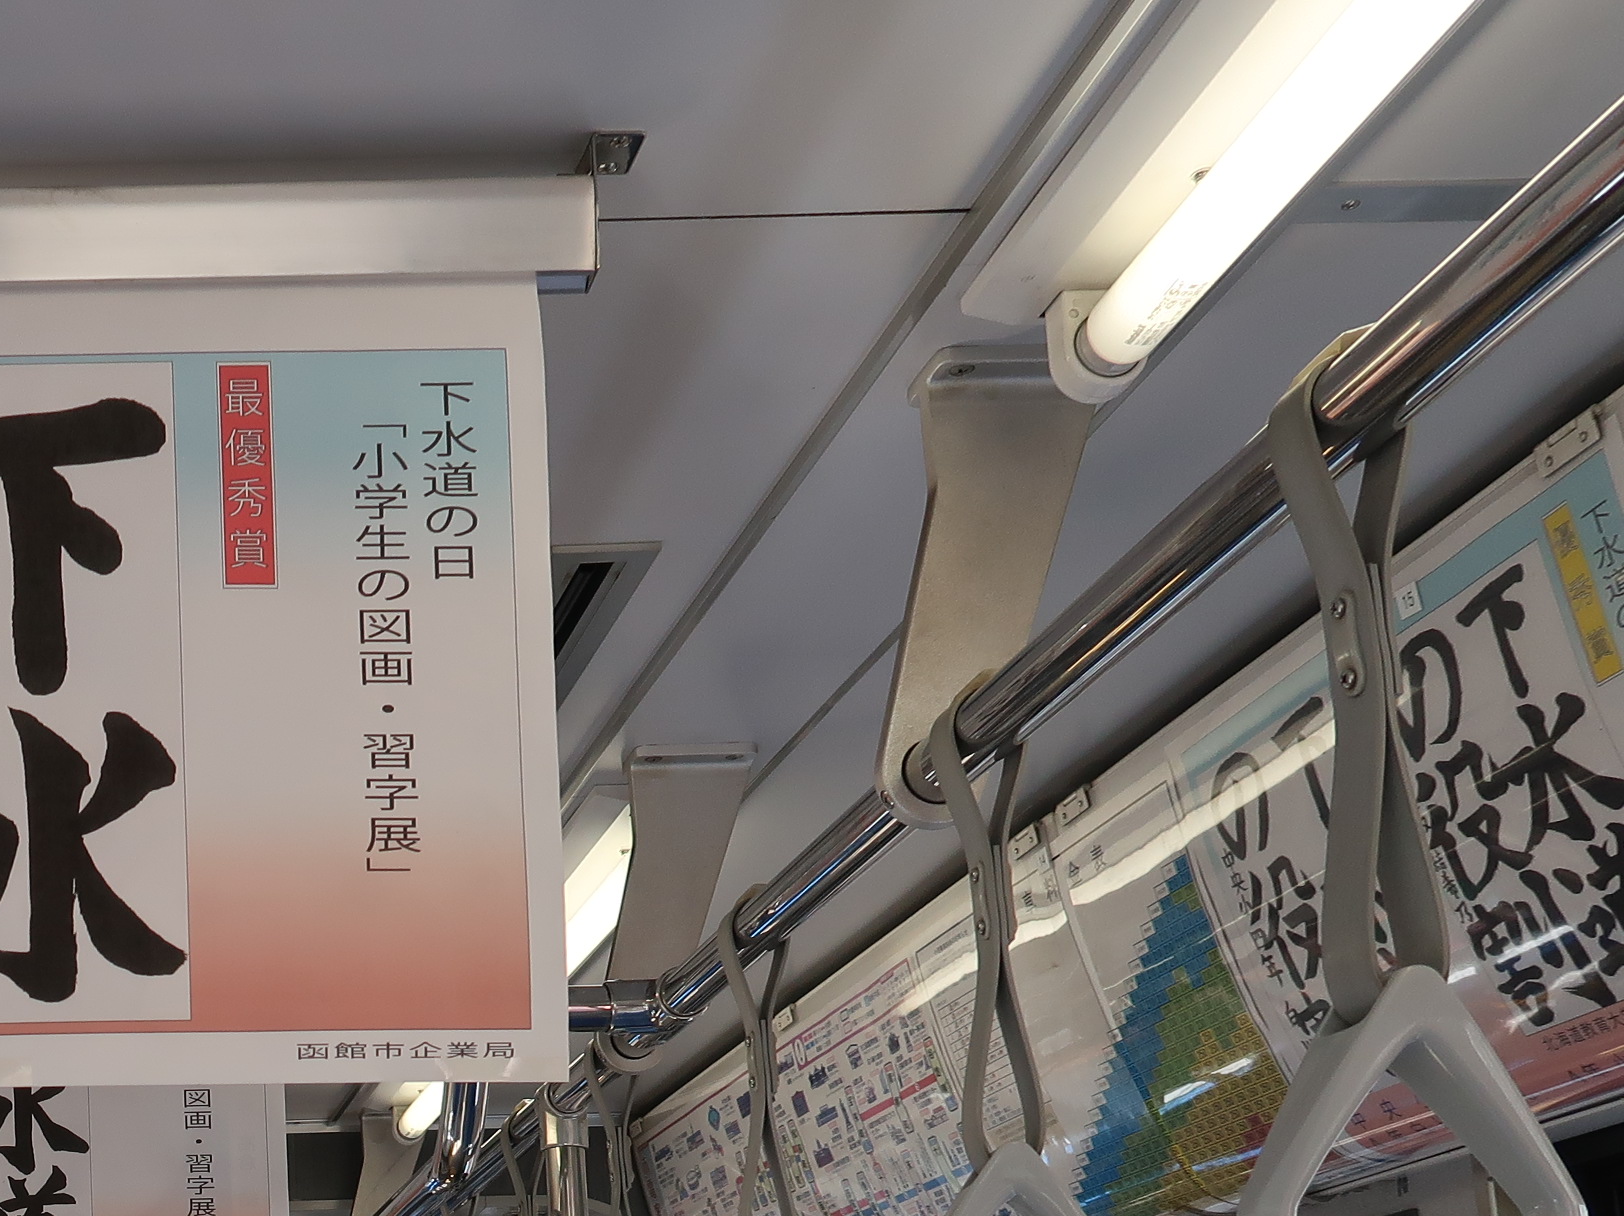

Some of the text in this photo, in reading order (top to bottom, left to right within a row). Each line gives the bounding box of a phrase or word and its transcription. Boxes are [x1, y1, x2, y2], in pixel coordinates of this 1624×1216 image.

[222, 378, 271, 573] 最優秀賞
[421, 380, 479, 582] 下水道の日
[1580, 500, 1624, 630] 下水道
[352, 419, 422, 876] 「小学生の図画・習字展」
[295, 1041, 517, 1063] 函館市企業局
[1542, 1010, 1624, 1052] 北海道教育大
